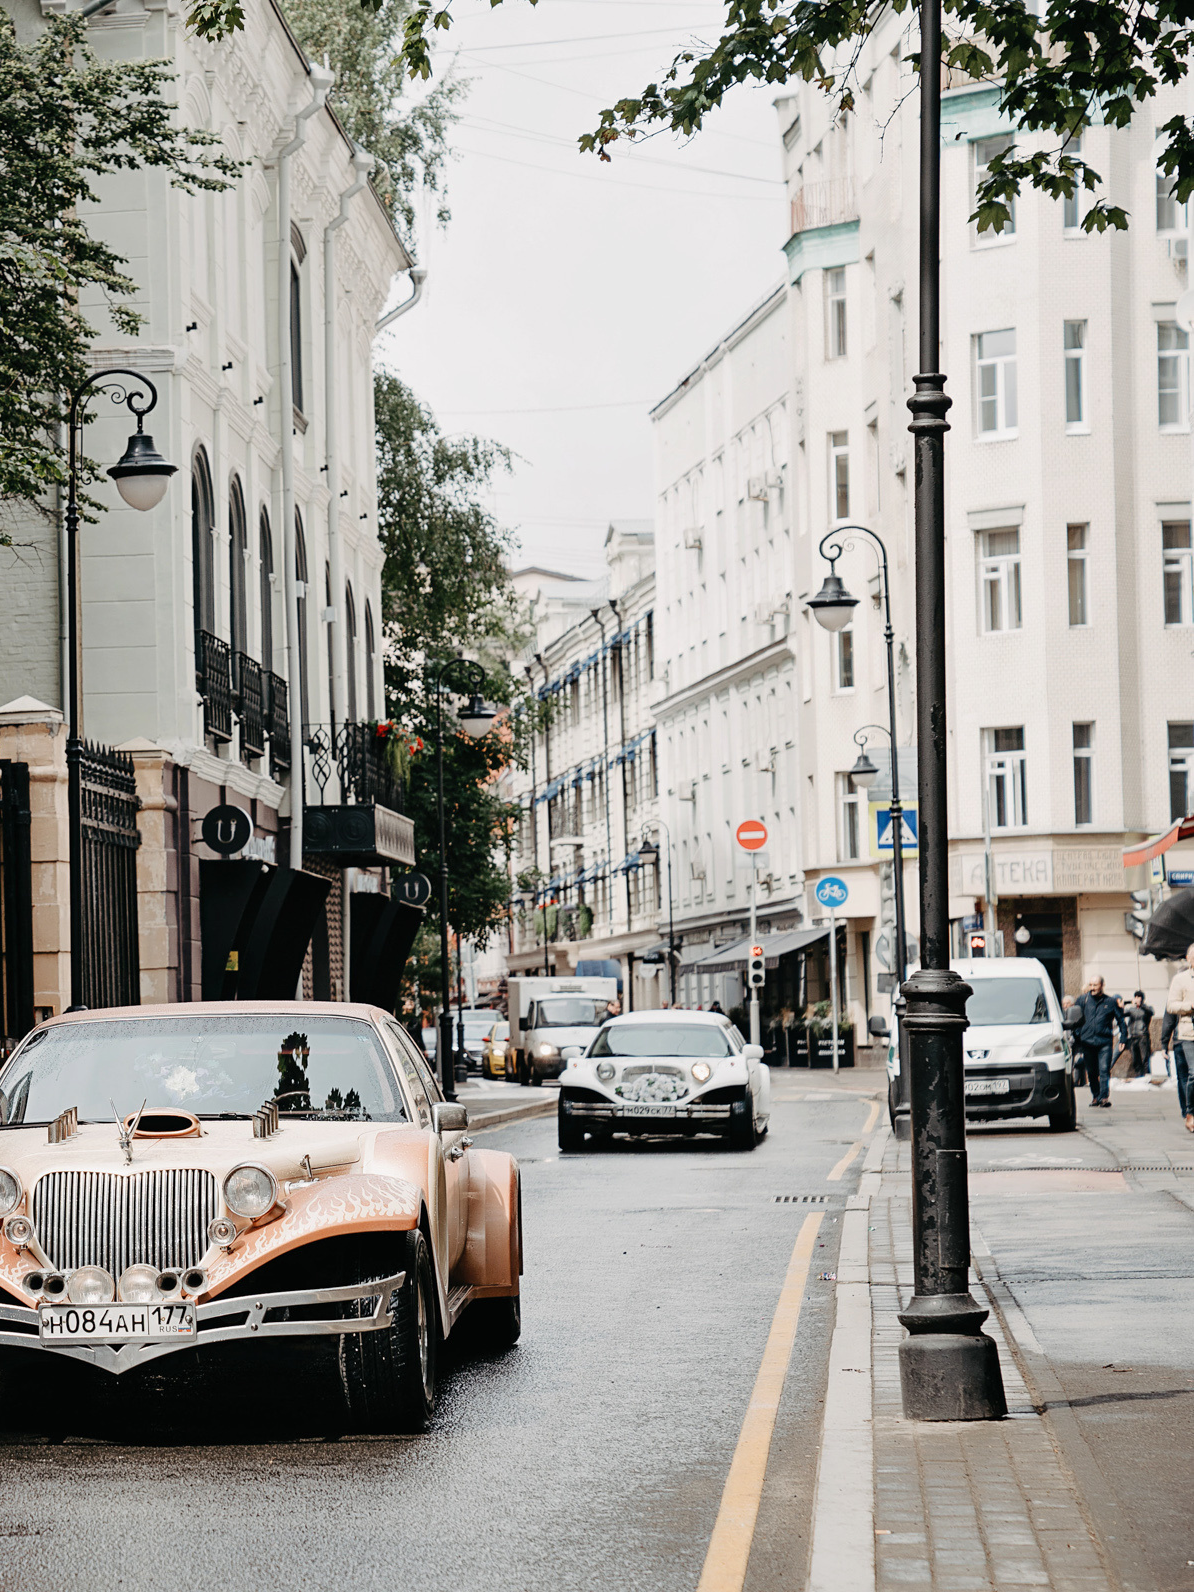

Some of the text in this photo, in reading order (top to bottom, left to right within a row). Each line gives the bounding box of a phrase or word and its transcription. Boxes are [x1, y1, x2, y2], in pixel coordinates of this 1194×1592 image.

[971, 860, 1048, 884] АТЕКА
[1171, 872, 1194, 881] СПИРИ
[49, 1305, 188, 1334] Н084АН 177
